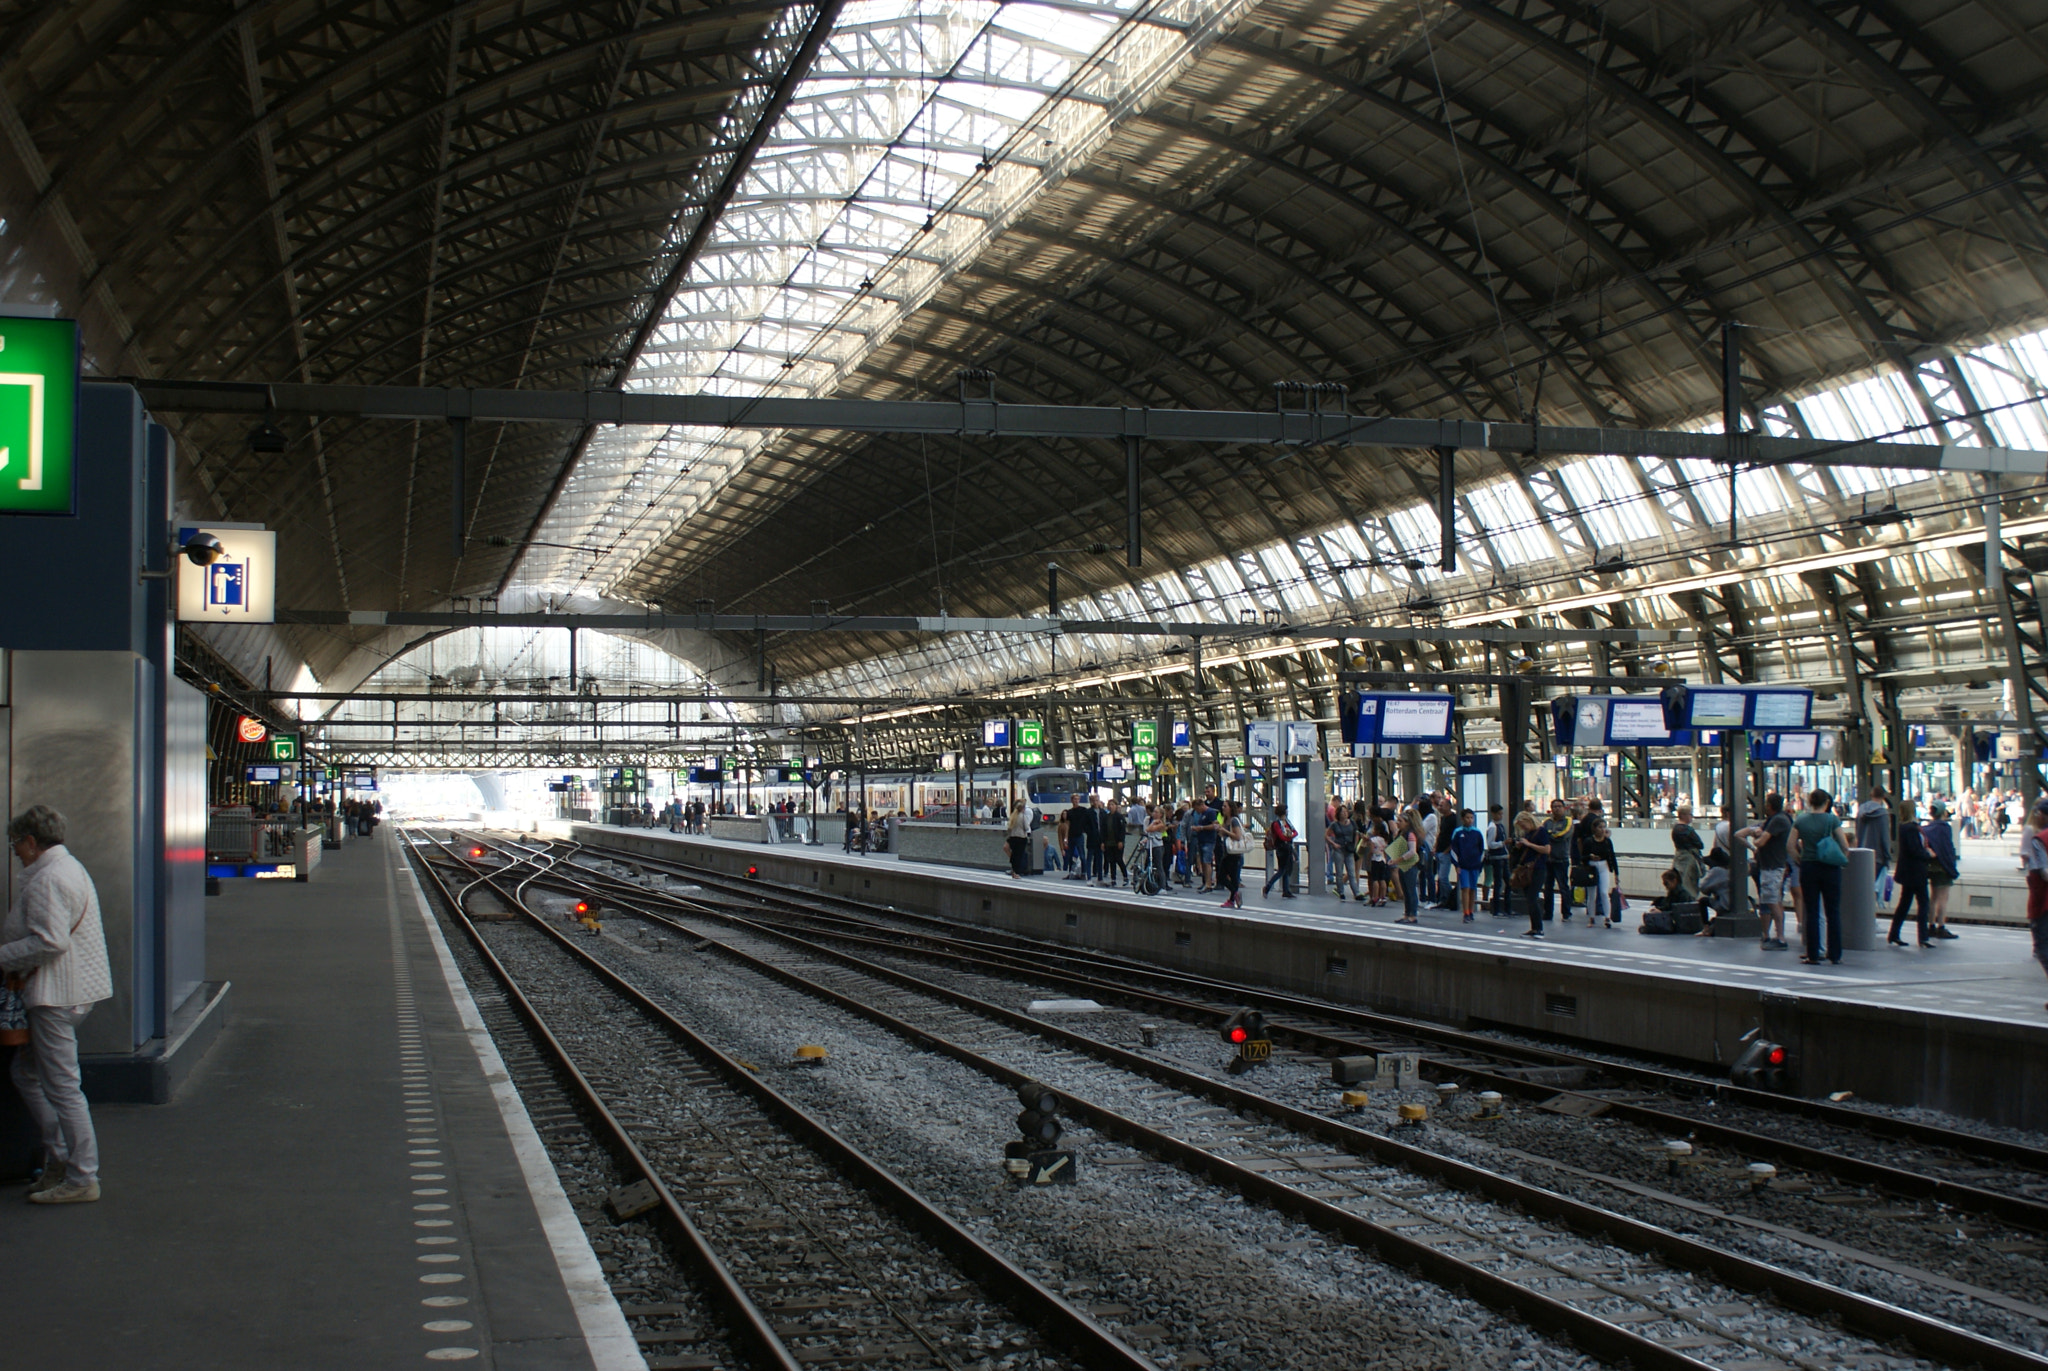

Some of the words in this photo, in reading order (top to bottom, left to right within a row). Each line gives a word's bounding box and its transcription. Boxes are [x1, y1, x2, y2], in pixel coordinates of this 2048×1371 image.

[244, 725, 262, 734] KING
[1361, 745, 1366, 756] J
[1387, 745, 1392, 756] J
[1248, 1043, 1268, 1057] 170
[1405, 1059, 1412, 1071] B
